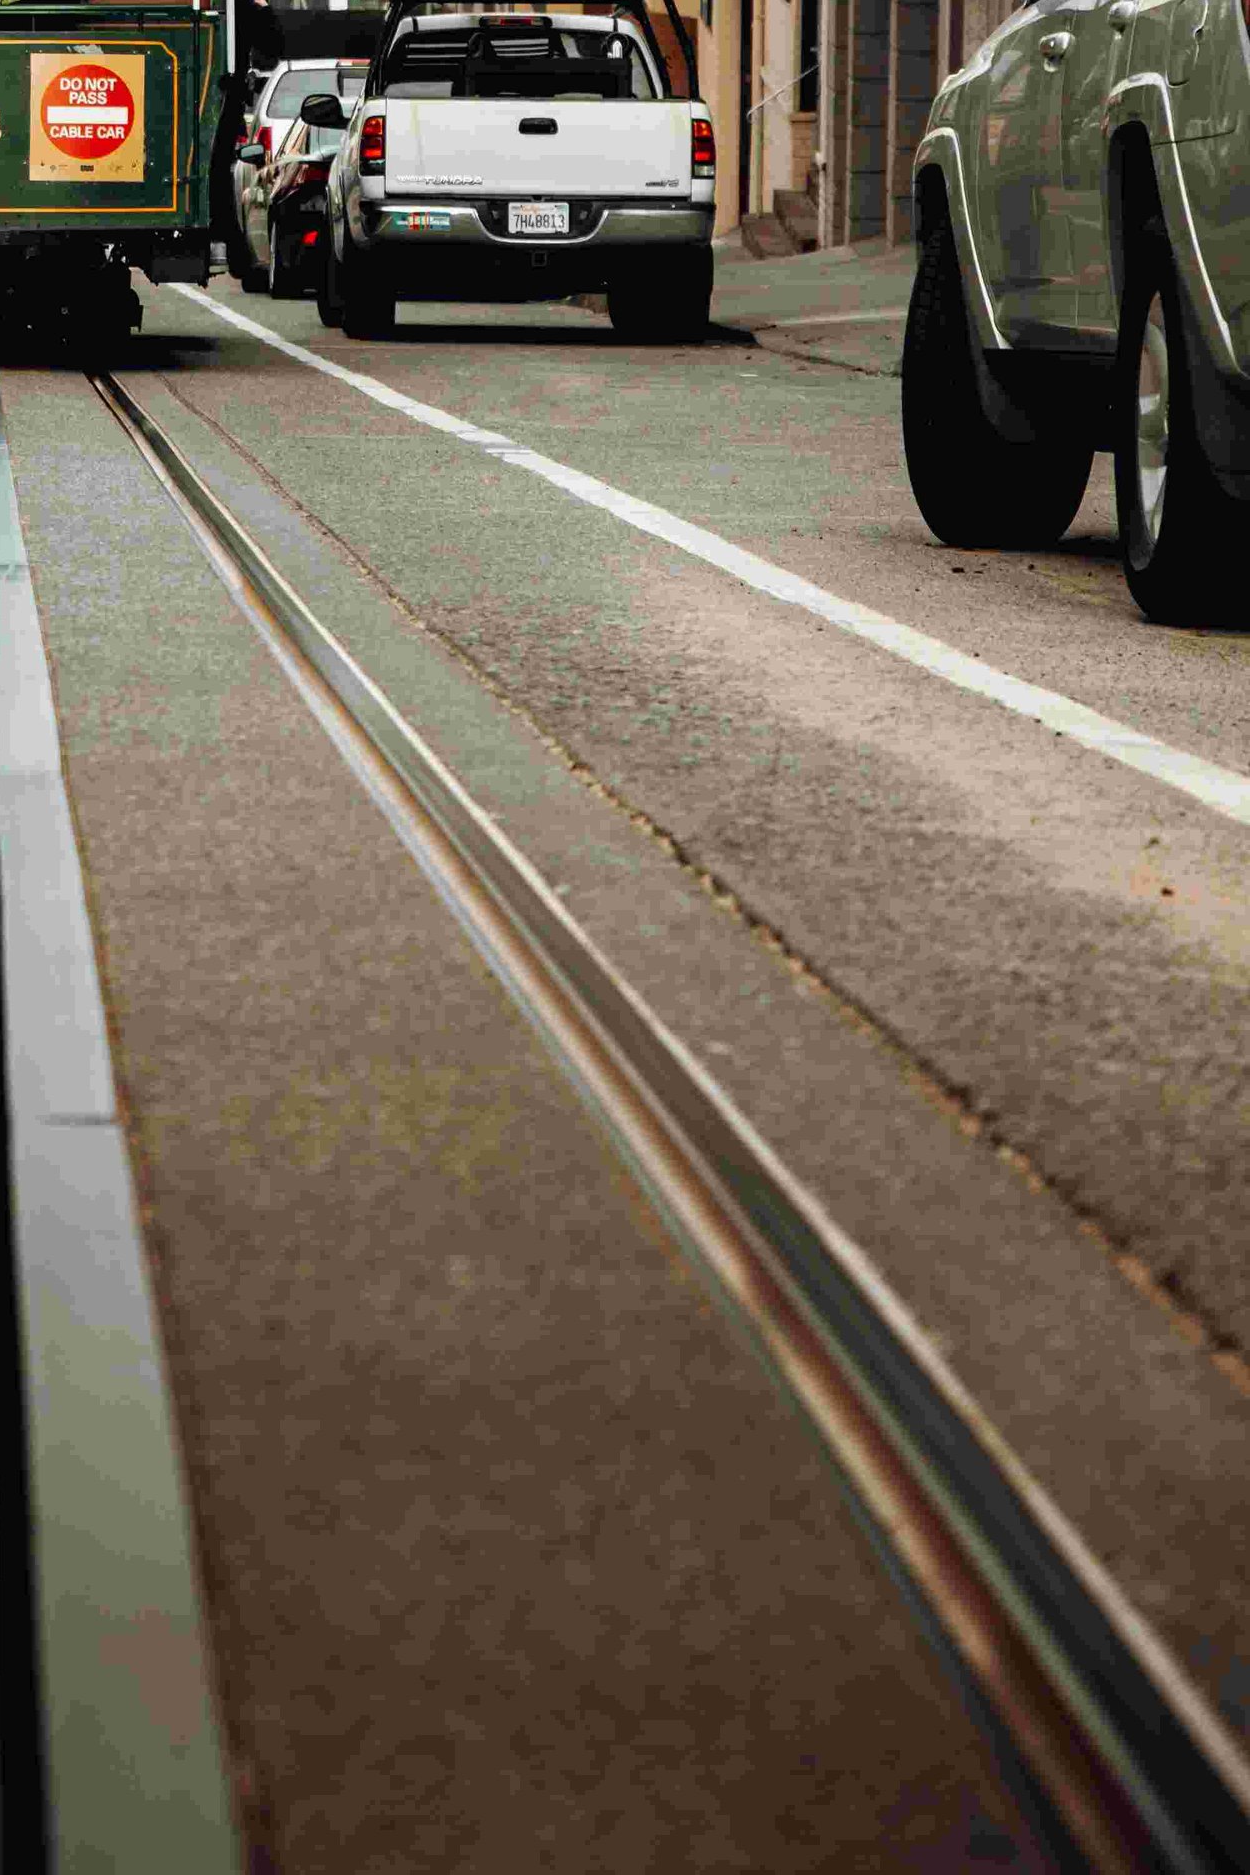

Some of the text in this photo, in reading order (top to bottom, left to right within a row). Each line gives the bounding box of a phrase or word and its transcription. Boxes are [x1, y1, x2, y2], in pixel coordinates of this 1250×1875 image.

[59, 77, 117, 91] DO NOT
[68, 91, 108, 105] PASS
[49, 126, 125, 140] CABLE CAR
[424, 173, 484, 186] TUNDRA
